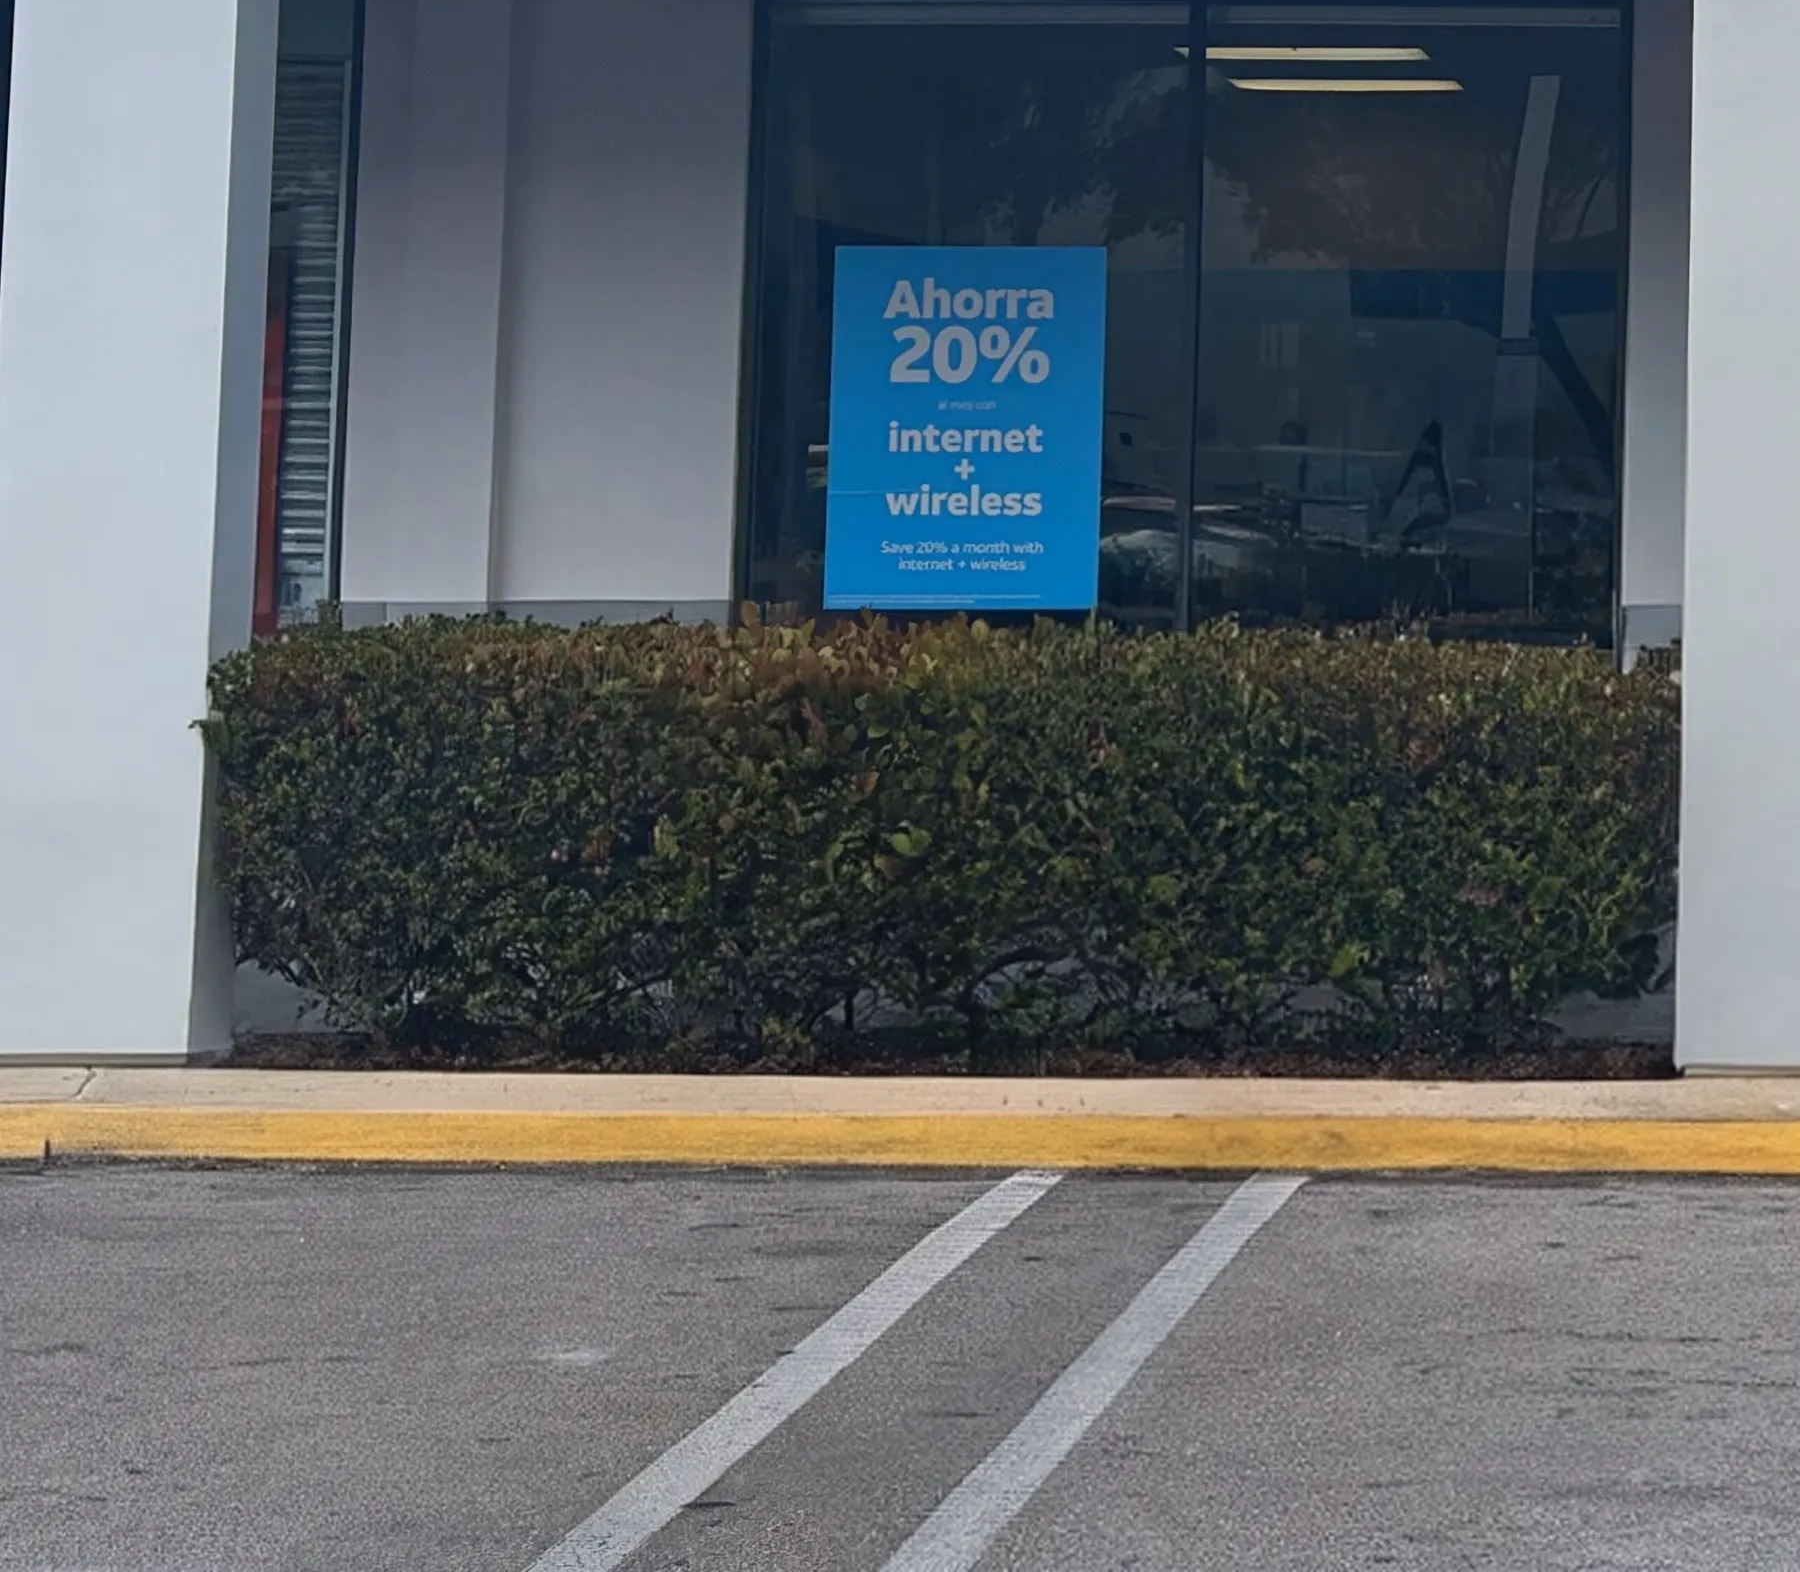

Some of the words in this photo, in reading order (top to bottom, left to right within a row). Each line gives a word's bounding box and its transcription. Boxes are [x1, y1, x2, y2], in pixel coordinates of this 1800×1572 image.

[883, 277, 1055, 320] Ahorra
[889, 325, 1050, 384] 20%
[888, 420, 1044, 454] internet
[954, 458, 975, 480] +
[885, 484, 1043, 517] wireless
[880, 540, 913, 554] Save
[916, 541, 948, 554] 20%
[951, 543, 960, 554] a
[963, 541, 1011, 554] month
[1013, 541, 1044, 554] with
[898, 557, 954, 571] internet
[970, 557, 1026, 571] wireless
